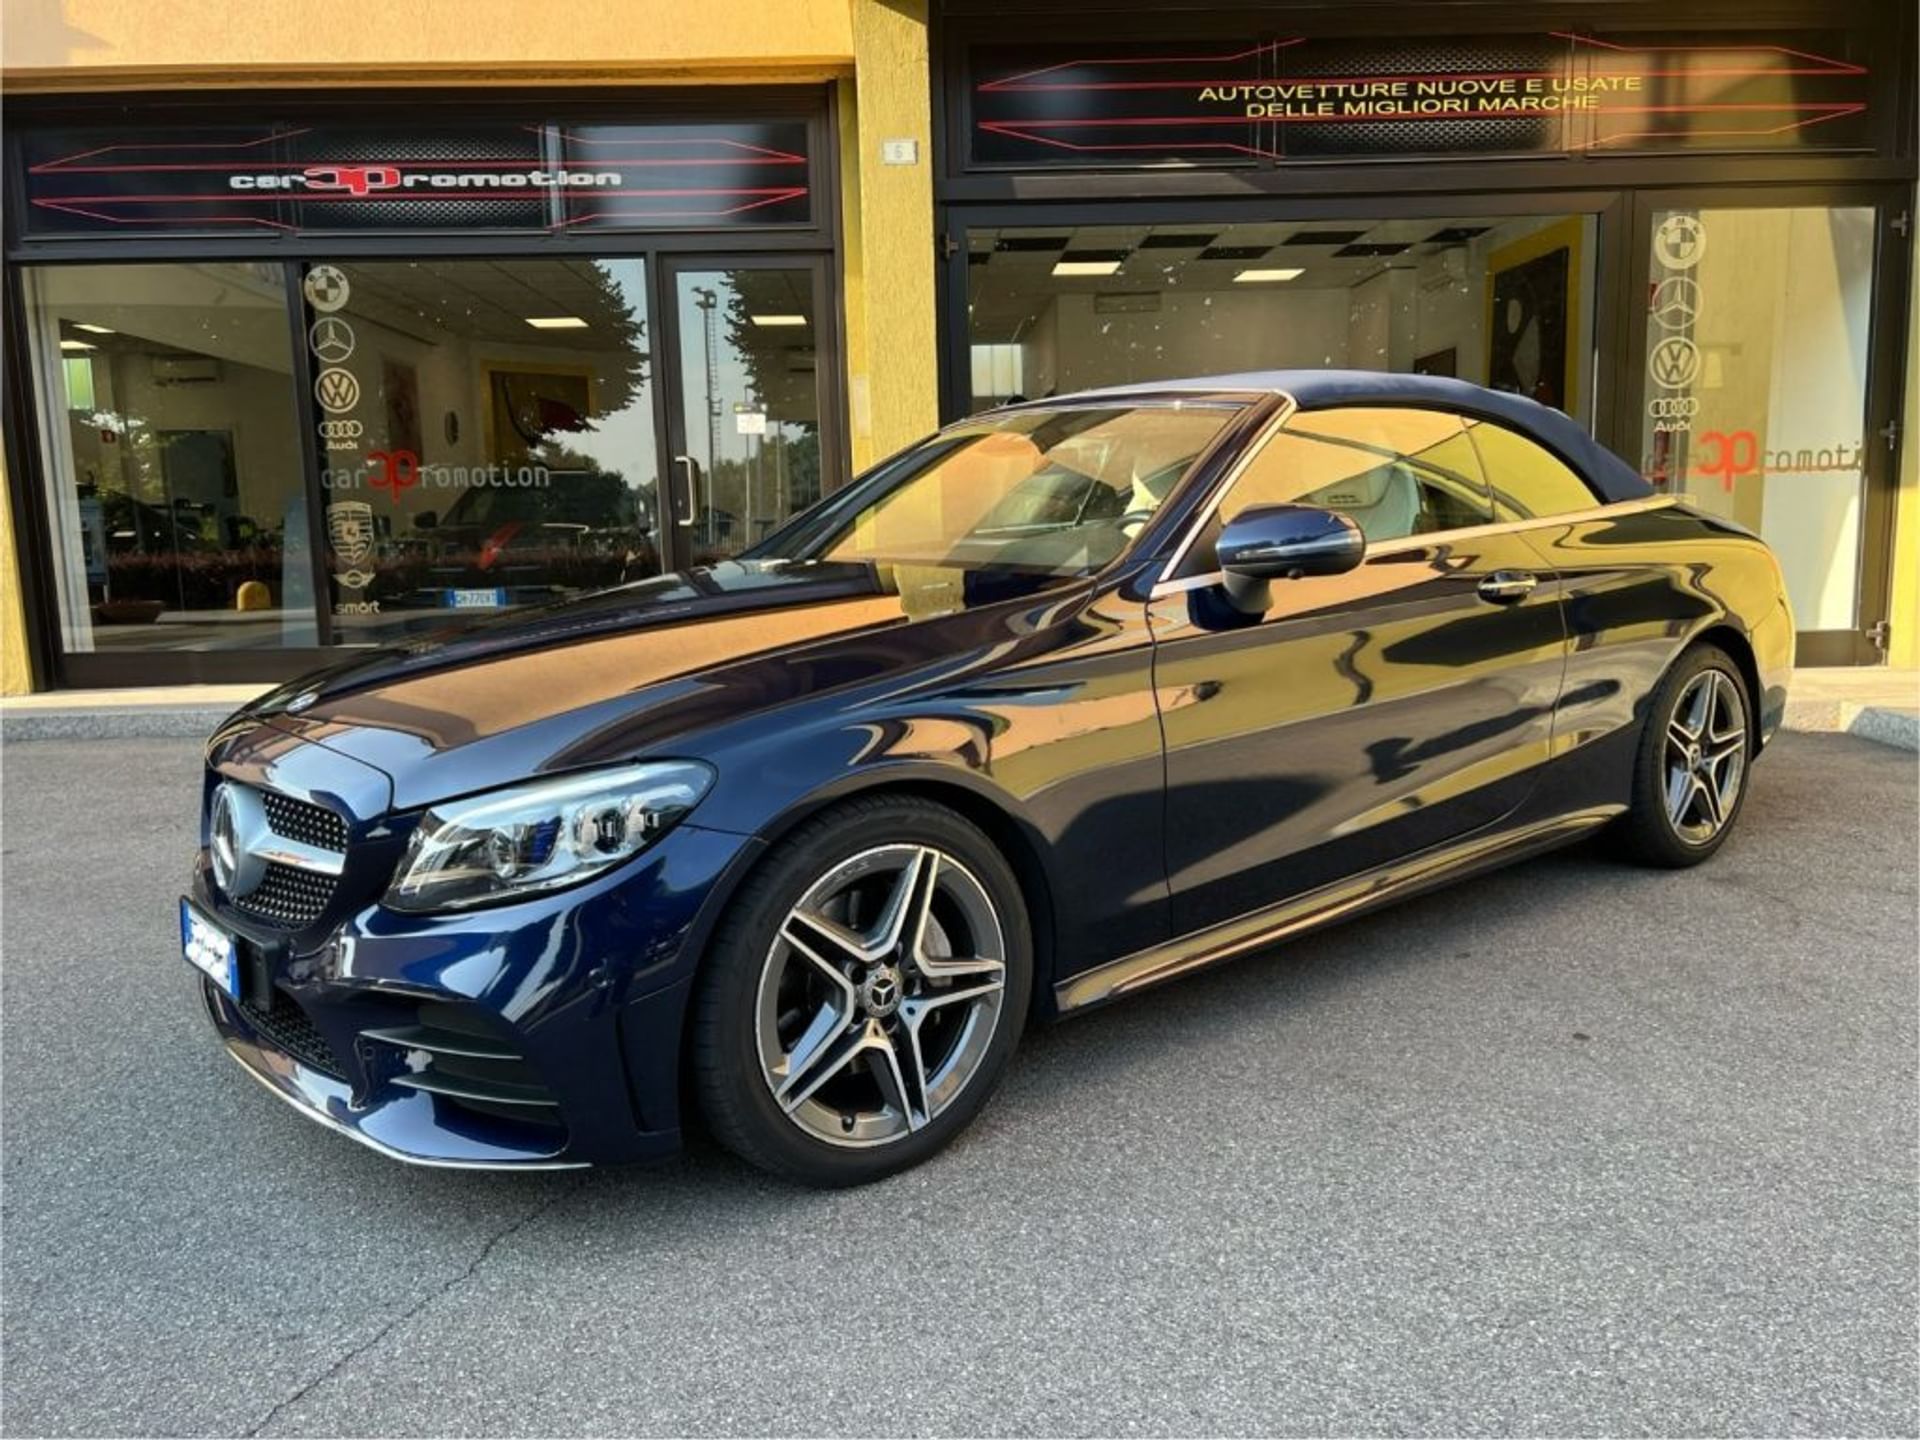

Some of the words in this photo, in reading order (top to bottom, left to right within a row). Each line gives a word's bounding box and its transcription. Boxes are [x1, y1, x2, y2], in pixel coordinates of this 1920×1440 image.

[1199, 82, 1408, 102] AUTOVETTURE
[1418, 79, 1515, 97] NUOVE
[1526, 78, 1543, 94] E
[1552, 76, 1642, 93] USATE
[1246, 102, 1335, 117] DELLE
[1344, 98, 1470, 115] MIGLIORI
[1478, 95, 1600, 112] MARCHE
[335, 601, 380, 615] smart
